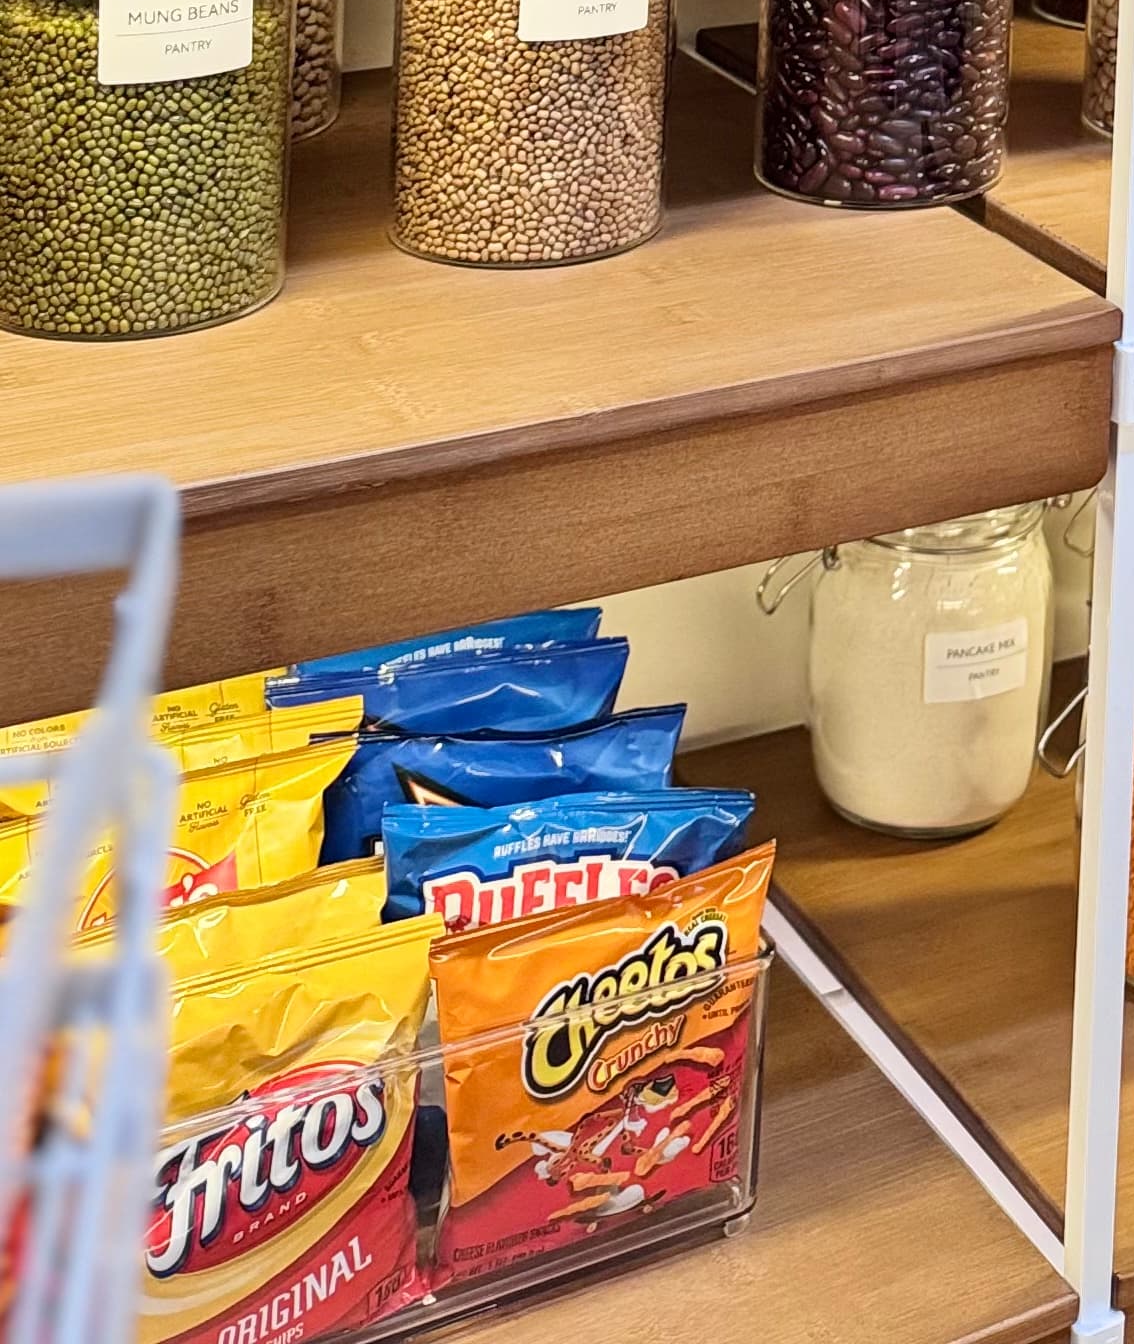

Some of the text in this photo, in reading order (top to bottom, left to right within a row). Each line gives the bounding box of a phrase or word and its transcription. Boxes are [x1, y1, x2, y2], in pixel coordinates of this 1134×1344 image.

[128, 0, 239, 25] MUNG BEANS
[578, 2, 617, 16] PANTRY
[164, 39, 213, 55] PANTRY
[152, 710, 198, 722] ARTIFICIAL
[12, 723, 66, 738] NO COLORS
[179, 805, 228, 823] ARTIFICIAL
[197, 800, 211, 810] NO
[244, 804, 266, 817] FREE
[493, 835, 541, 859] RUFFLES
[543, 831, 571, 847] HAVE
[526, 924, 723, 1093] Cheetos
[587, 1014, 687, 1091] Crunchy
[145, 1077, 386, 1278] Fritos
[233, 1192, 308, 1243] BRAND
[453, 1243, 486, 1262] CHEESE
[217, 1236, 373, 1344] ORIGINAL
[271, 1322, 304, 1344] HIPS
